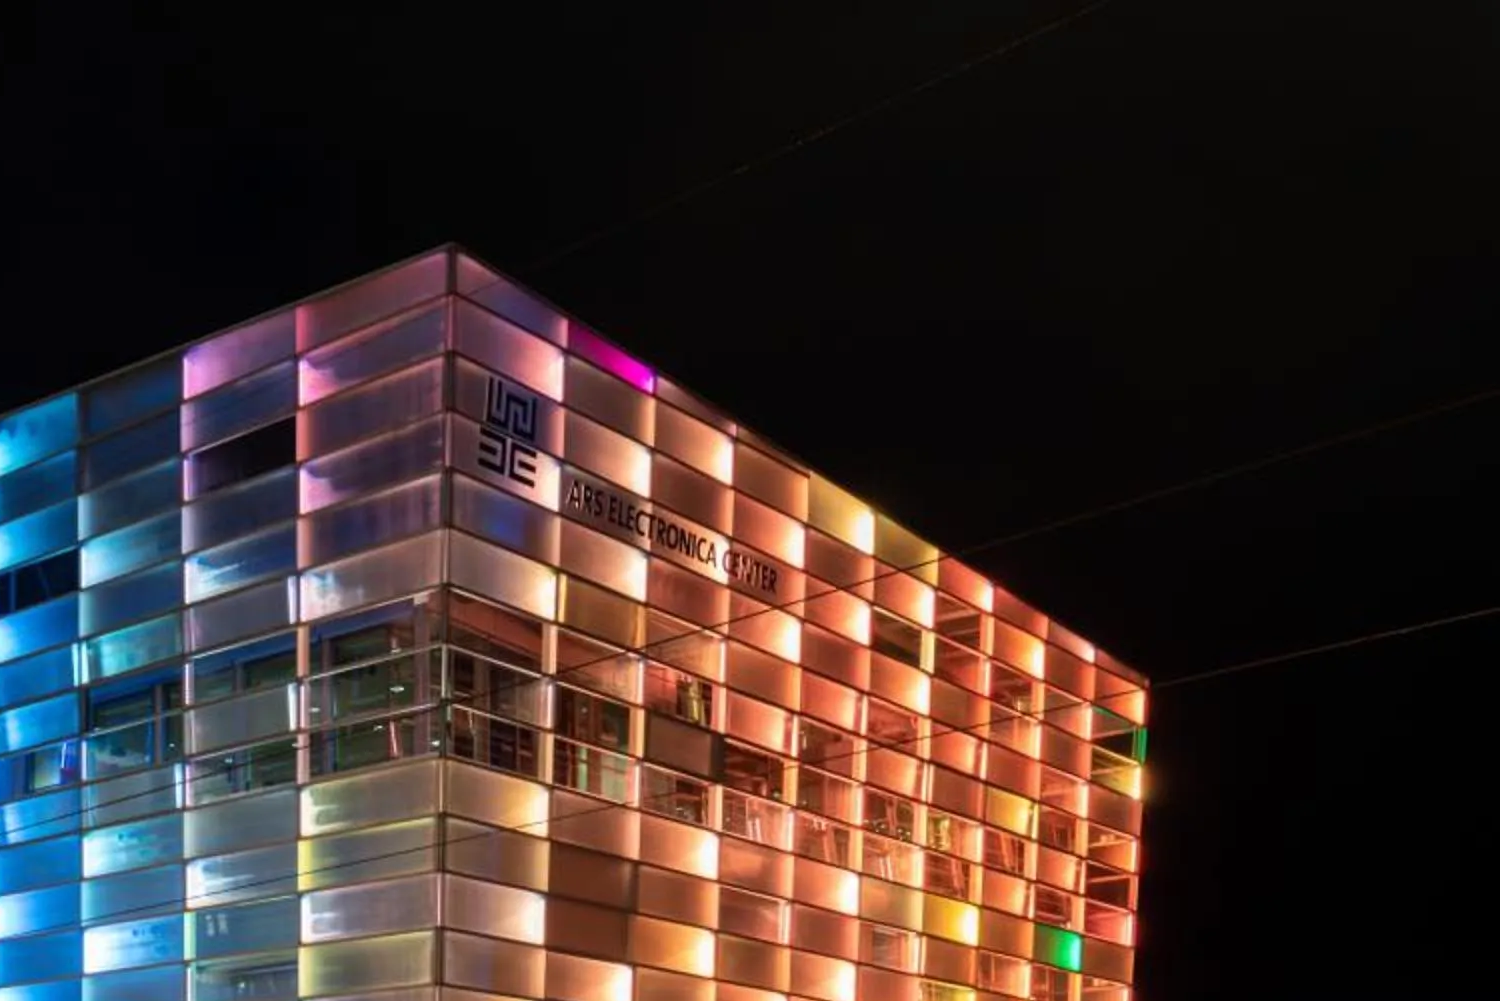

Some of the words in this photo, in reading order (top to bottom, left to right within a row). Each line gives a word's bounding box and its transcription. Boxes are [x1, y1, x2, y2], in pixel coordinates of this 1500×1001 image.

[565, 480, 603, 517] ARS
[607, 493, 717, 569] ELECTRONICA
[722, 548, 778, 595] CENTER
